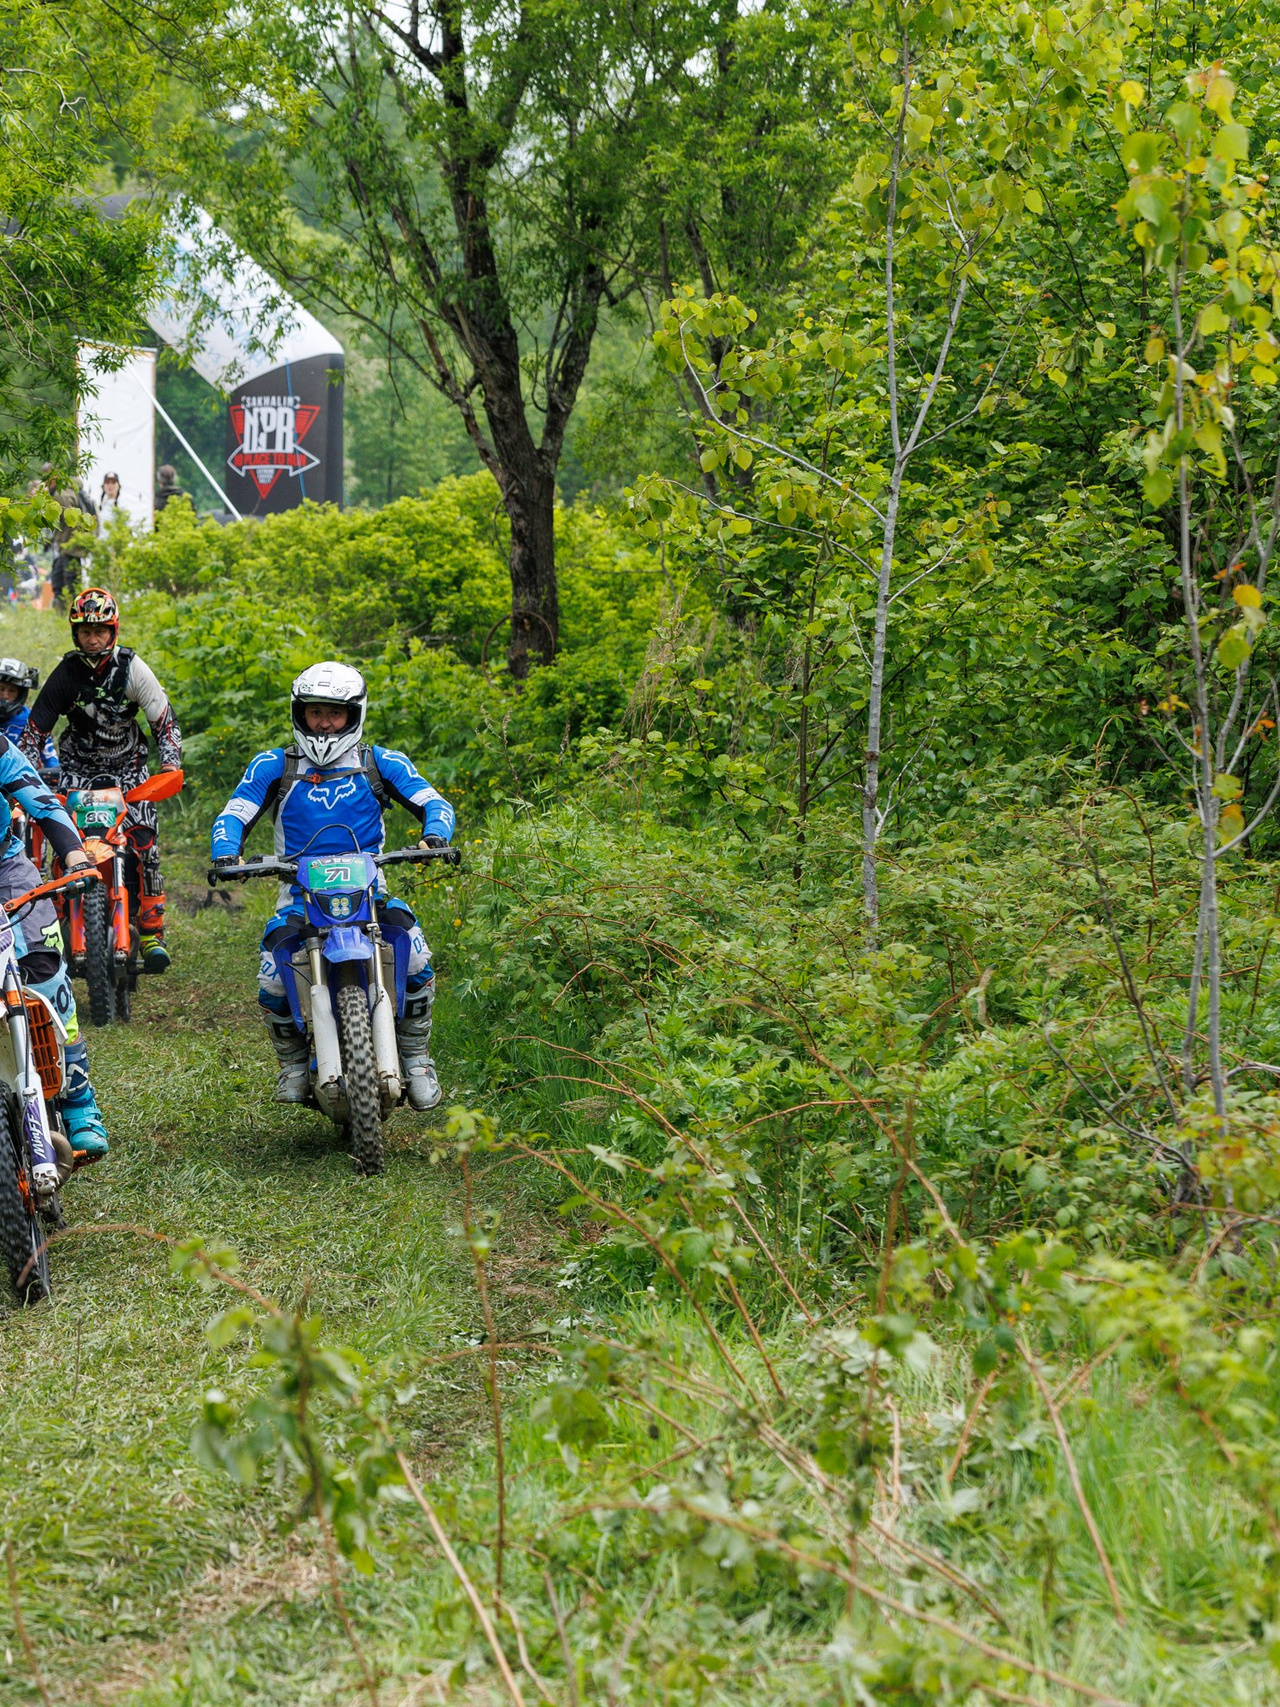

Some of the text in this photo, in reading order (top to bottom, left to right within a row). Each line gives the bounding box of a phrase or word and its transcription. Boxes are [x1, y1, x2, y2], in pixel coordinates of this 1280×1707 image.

[245, 395, 294, 408] SAKHALIN
[243, 407, 295, 453] NPR
[324, 867, 350, 883] 71
